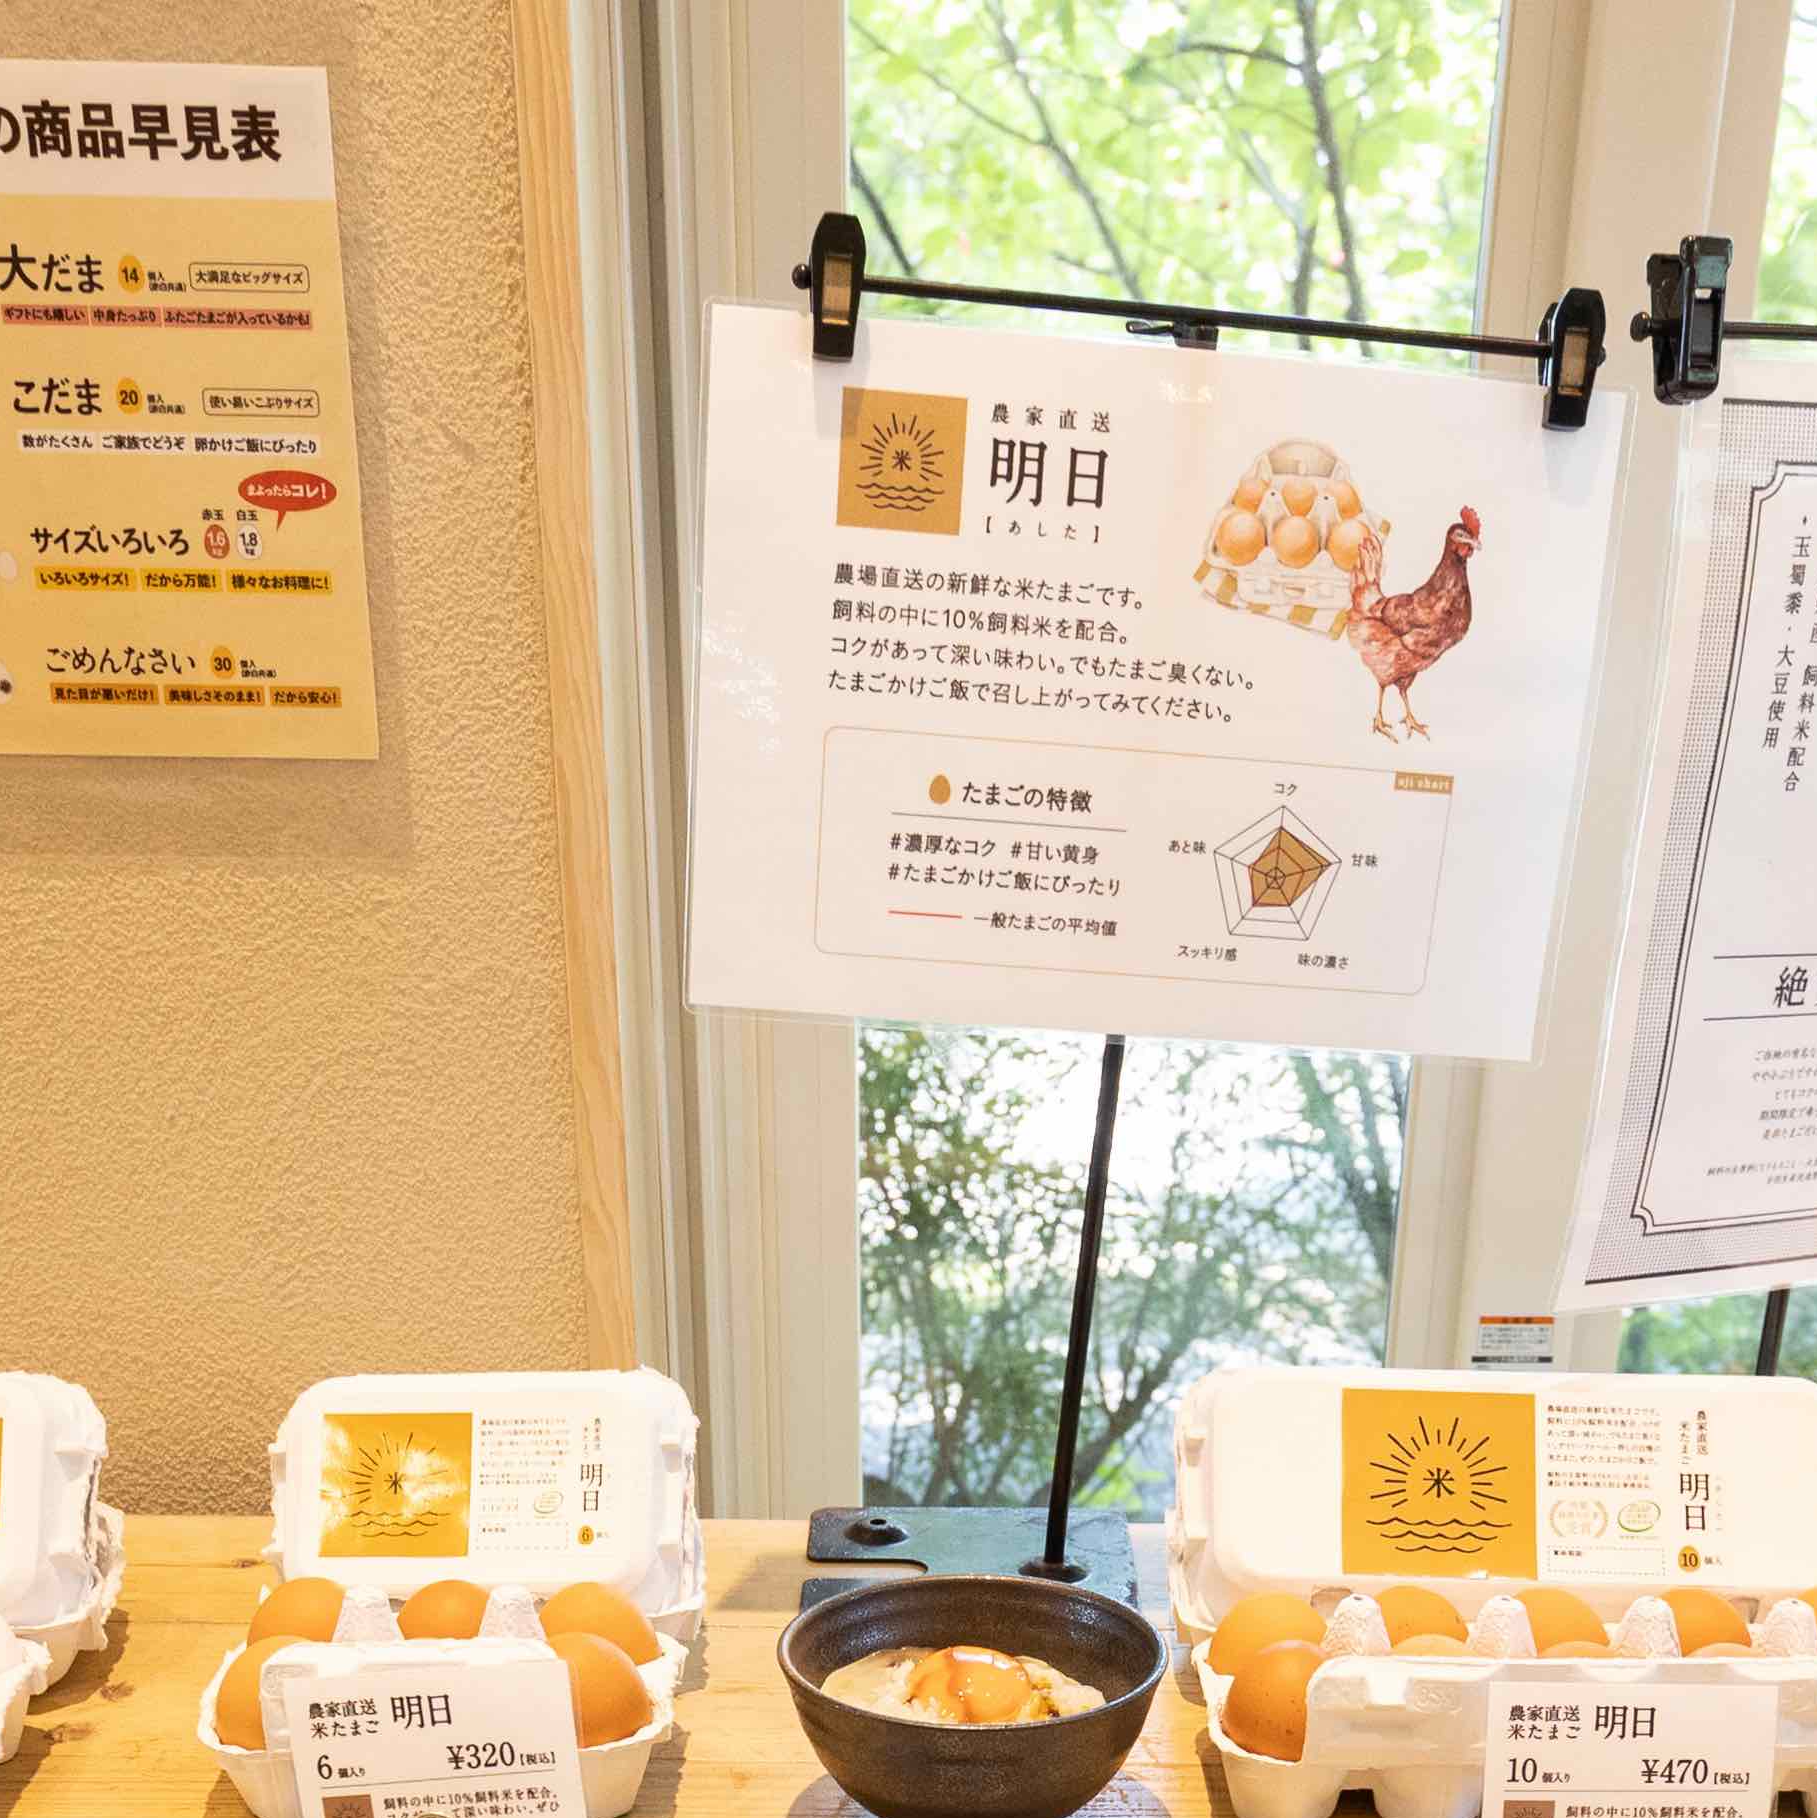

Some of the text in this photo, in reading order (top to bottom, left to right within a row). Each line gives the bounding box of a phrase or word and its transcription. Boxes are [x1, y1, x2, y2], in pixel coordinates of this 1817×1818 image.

[121, 266, 139, 283] 14
[195, 270, 304, 285] 大満足なビッグサイズ
[93, 308, 157, 324] 中身たっぷり
[13, 377, 103, 416] こだま
[119, 389, 138, 405] 20
[990, 402, 1113, 435] 農家直送
[22, 433, 318, 455] 数がたくさん ご家族でどうぞ 卵かけご飯にぴったり
[891, 436, 1110, 510] 米 明日
[246, 481, 328, 500] まよったらコレ!
[201, 509, 259, 522] 赤玉 白玉
[985, 515, 1101, 545] 【あした】
[30, 523, 258, 556] サイズいろいろ 1.8
[39, 571, 330, 591] いろいろサイズ! だから万能! 様々なお料理に!
[833, 562, 1146, 612] 農場直送の新鮮な米たまごです。
[831, 598, 1131, 647] 飼料の中に10%飼料米を配合。
[45, 645, 233, 676] ごめんなさい 30
[829, 633, 1256, 693] コクがあって深い味わい。でもたまご臭くない。
[273, 690, 337, 706] だから安心!
[827, 667, 1234, 724] たまごかけご飯で召し上がってみてください。
[961, 780, 1094, 815] たまごの特徴
[1273, 782, 1299, 797] コク
[889, 831, 1101, 866] #濃厚なコク #甘い黄身
[1167, 839, 1208, 856] あと味
[1350, 853, 1380, 869] 甘味
[887, 861, 1122, 898] #たまごかけご飯にぴったり
[972, 909, 1118, 938] 一般たまごの平均値
[1176, 944, 1238, 963] スッキリ感
[580, 1463, 603, 1513] 明日
[1423, 1466, 1456, 1498] 米
[1678, 1472, 1710, 1532] 明日
[308, 1694, 453, 1730] 農家直送 明日
[1508, 1703, 1657, 1741] 農家直送 明日
[310, 1719, 380, 1740] 米たまご
[1507, 1723, 1582, 1741] 米たまご
[316, 1741, 557, 1780] 6 ¥320 【税込】
[1505, 1757, 1751, 1787] 10 個入り ¥470 【税込】
